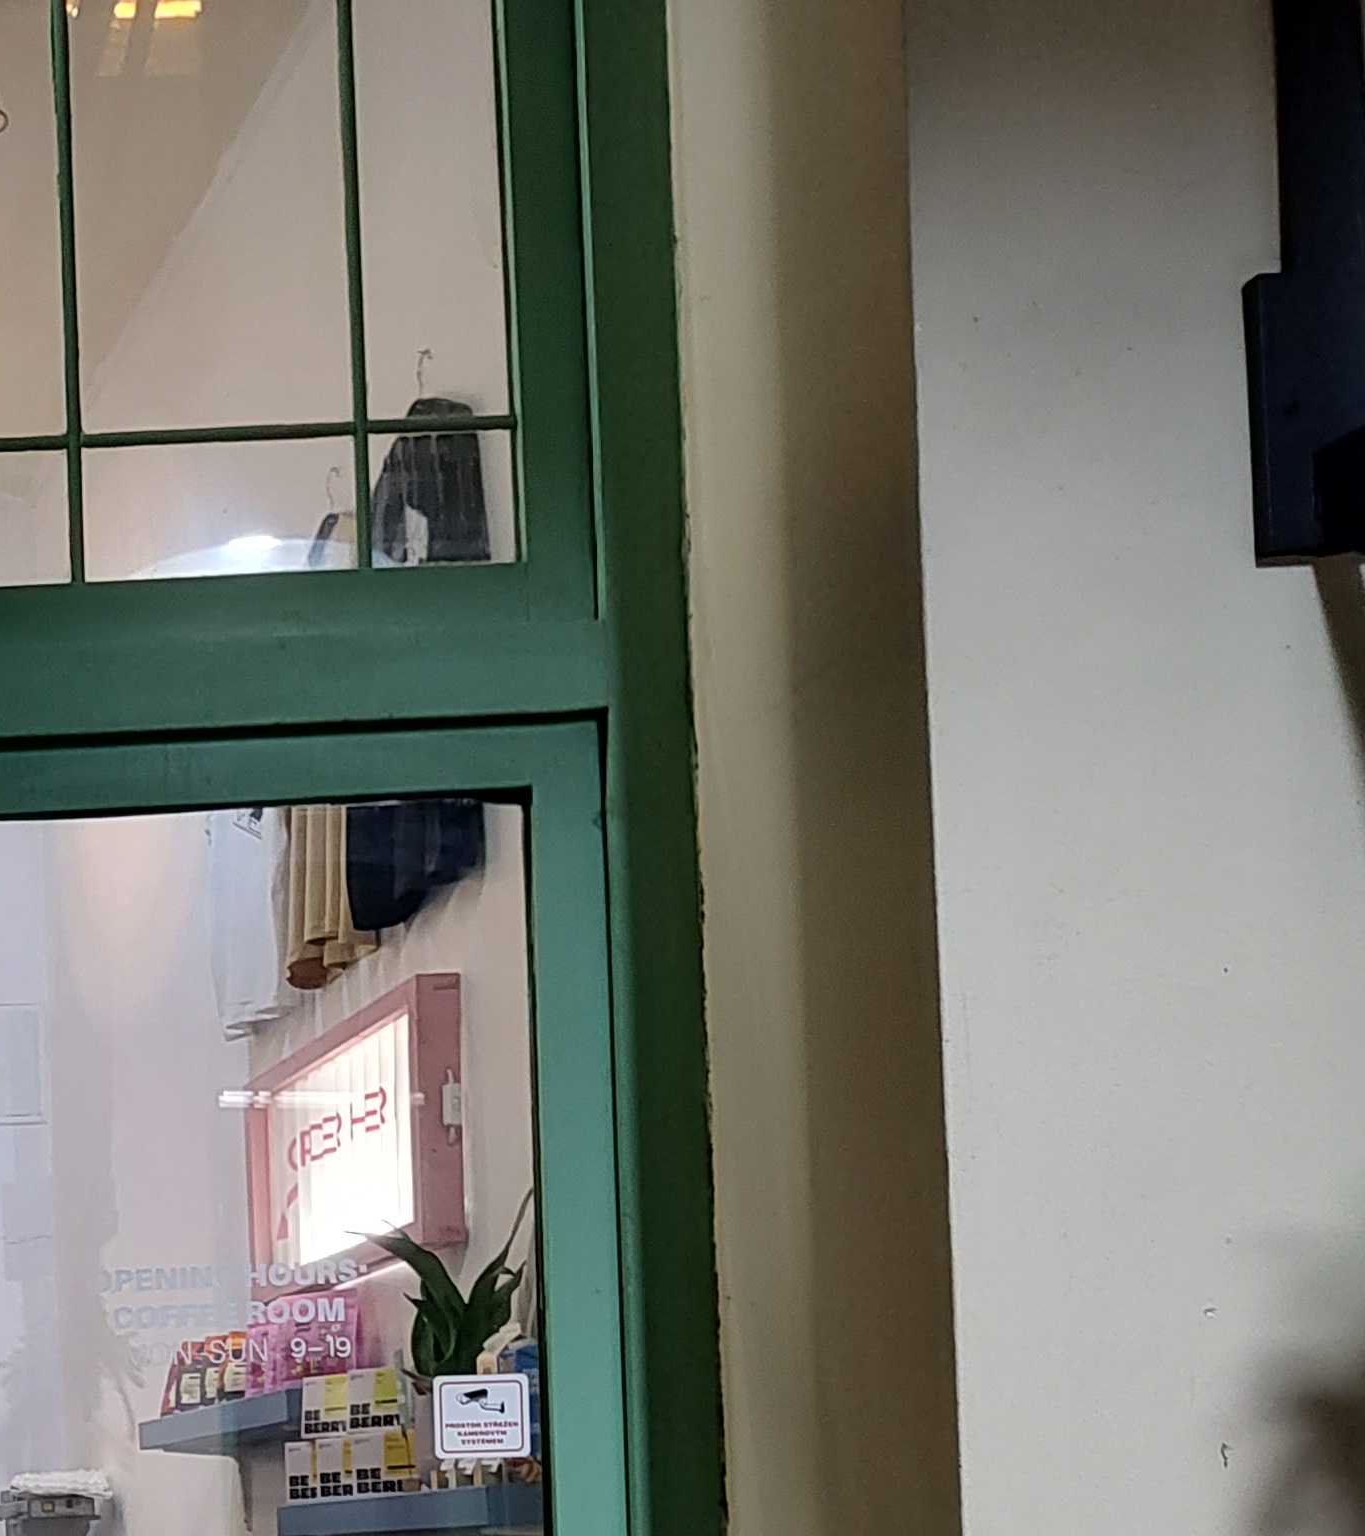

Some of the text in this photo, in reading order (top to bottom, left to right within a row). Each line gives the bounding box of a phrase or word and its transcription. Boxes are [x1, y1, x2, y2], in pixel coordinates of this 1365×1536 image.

[90, 1264, 233, 1293] OPENIN
[113, 1297, 345, 1330] COFFEE ROOM
[305, 1410, 321, 1421] BE
[350, 1403, 370, 1416] BE
[320, 1472, 341, 1484] BE
[356, 1468, 381, 1480] BE
[289, 1475, 309, 1487] BE
